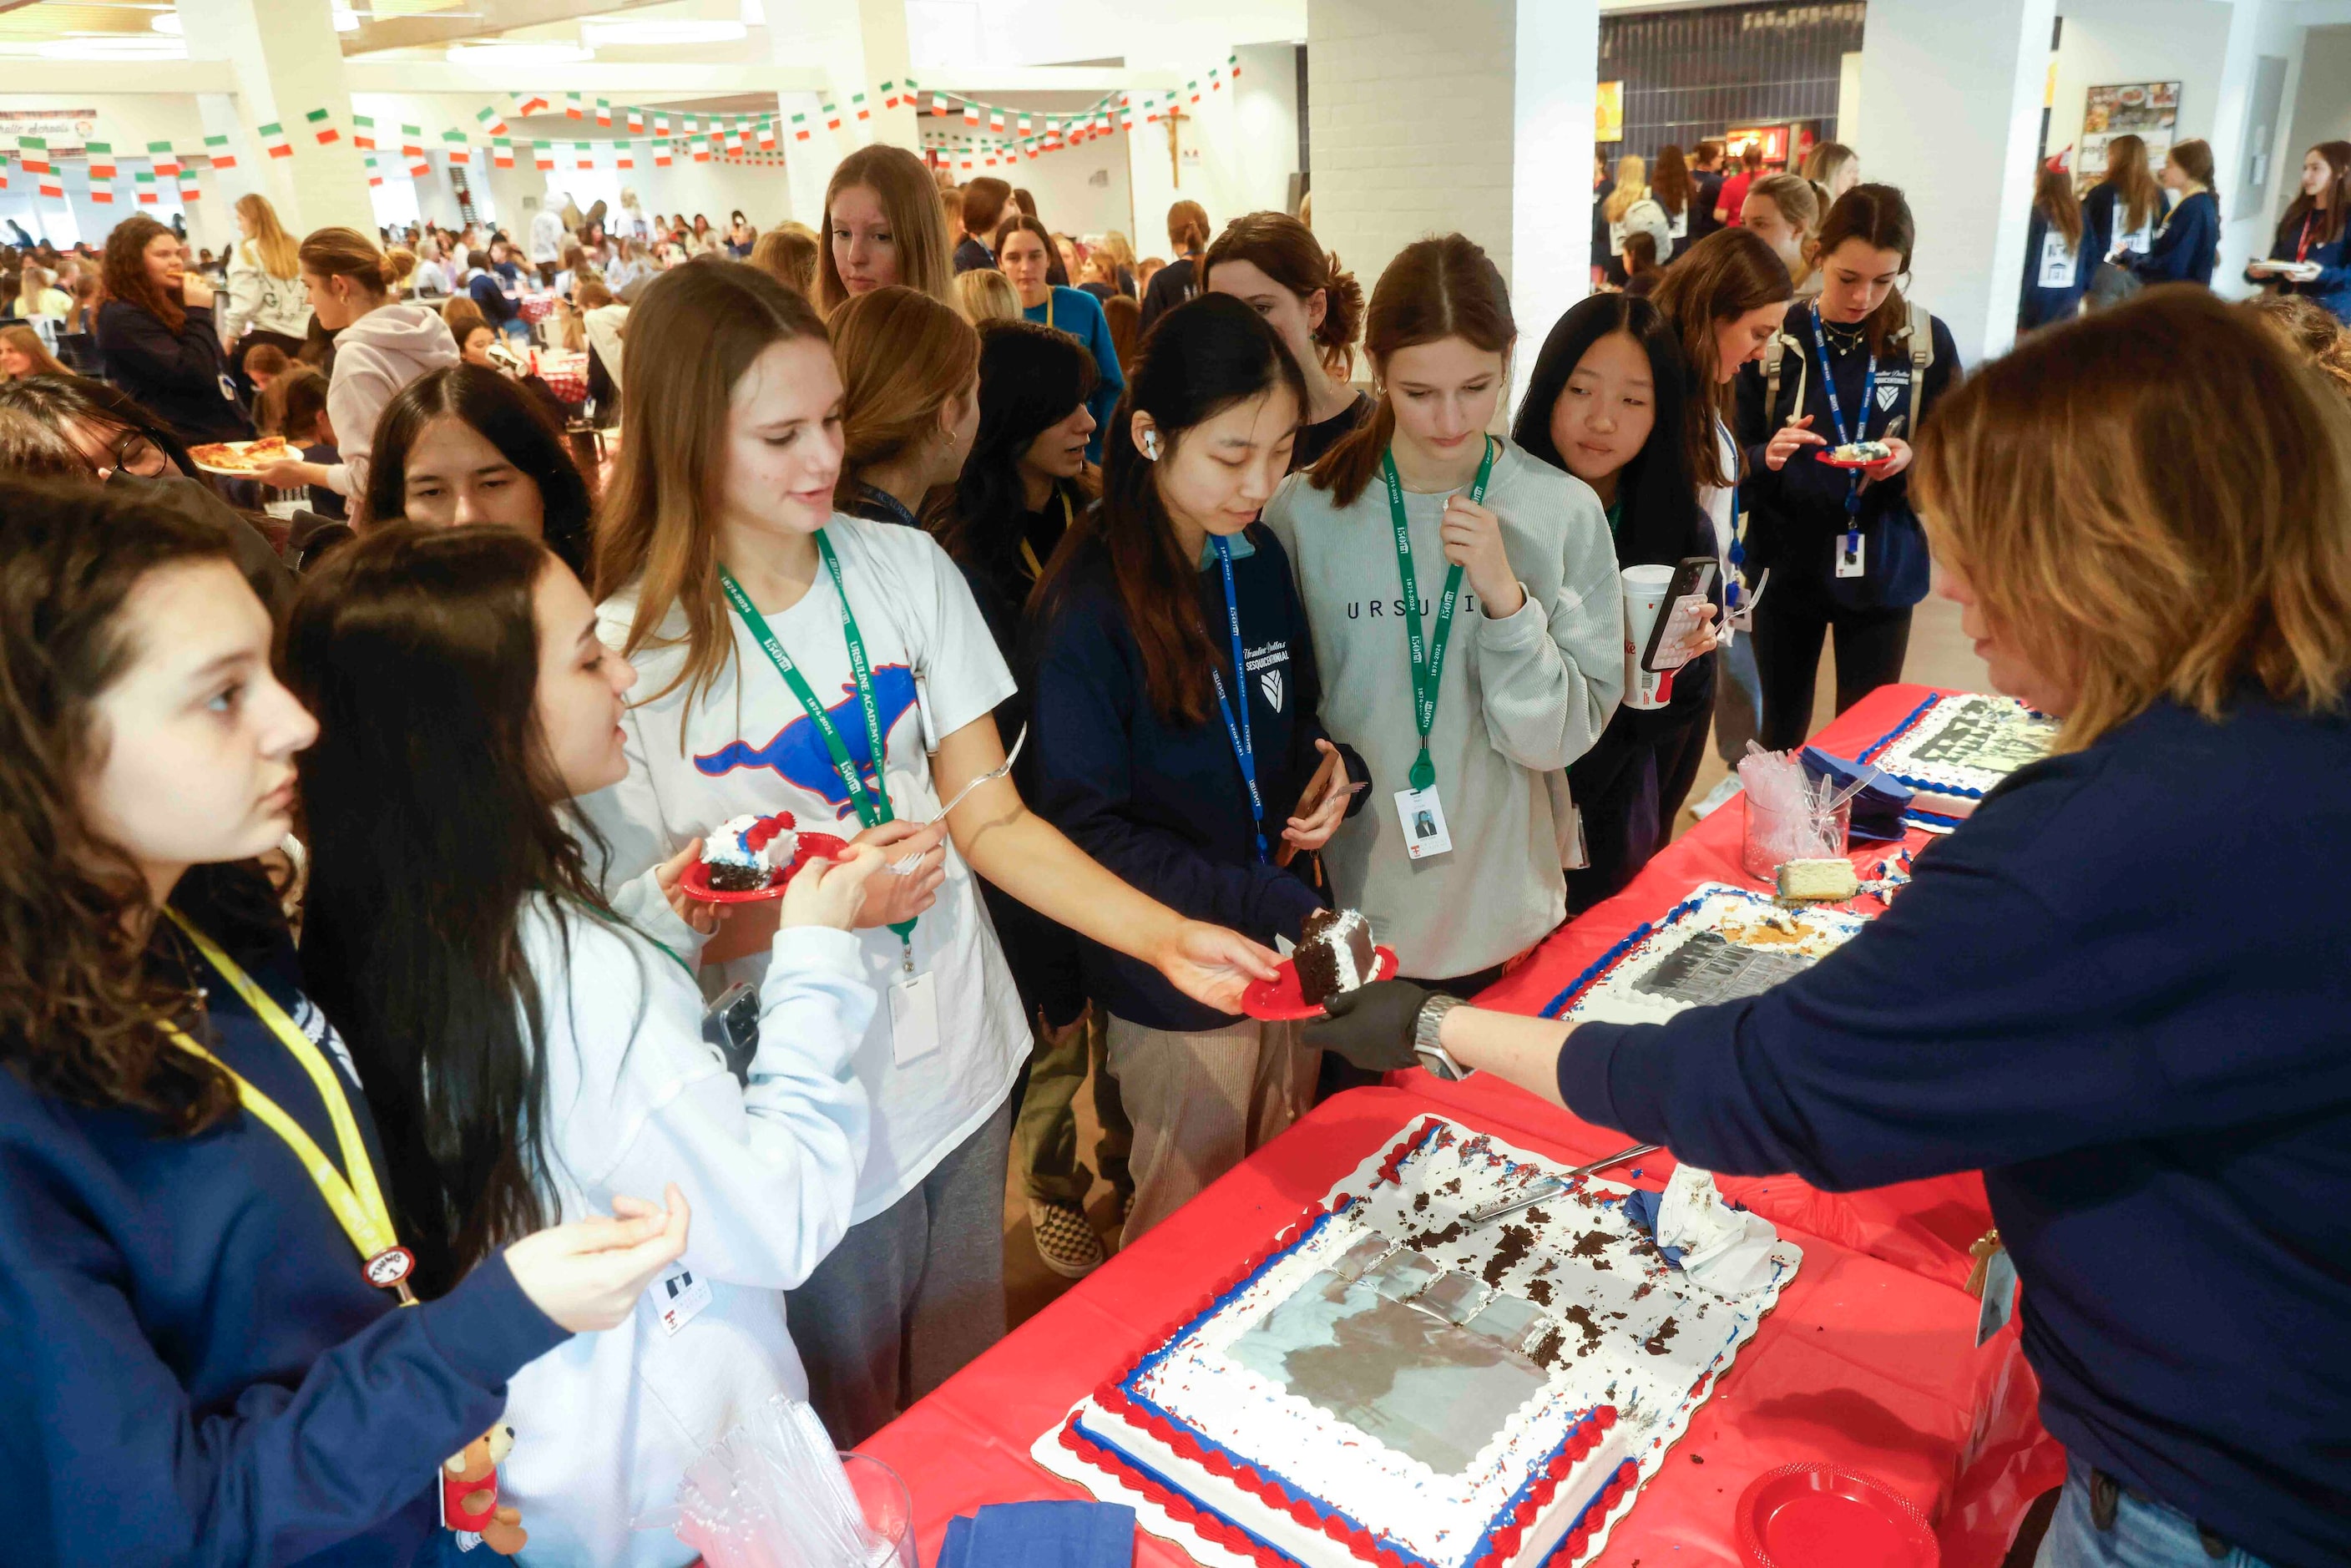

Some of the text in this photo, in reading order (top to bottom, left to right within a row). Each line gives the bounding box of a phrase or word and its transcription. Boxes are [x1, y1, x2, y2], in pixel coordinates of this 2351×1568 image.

[1388, 473, 1399, 504] 1874-2024
[1407, 578, 1416, 611] 1874-2024
[721, 576, 751, 614] 1874-2024
[806, 698, 834, 735] 1874-2024
[850, 640, 870, 691] URSULINE
[862, 693, 880, 745] ACADEMY
[1431, 644, 1442, 676] 1874-2024
[371, 1253, 402, 1279] THING
